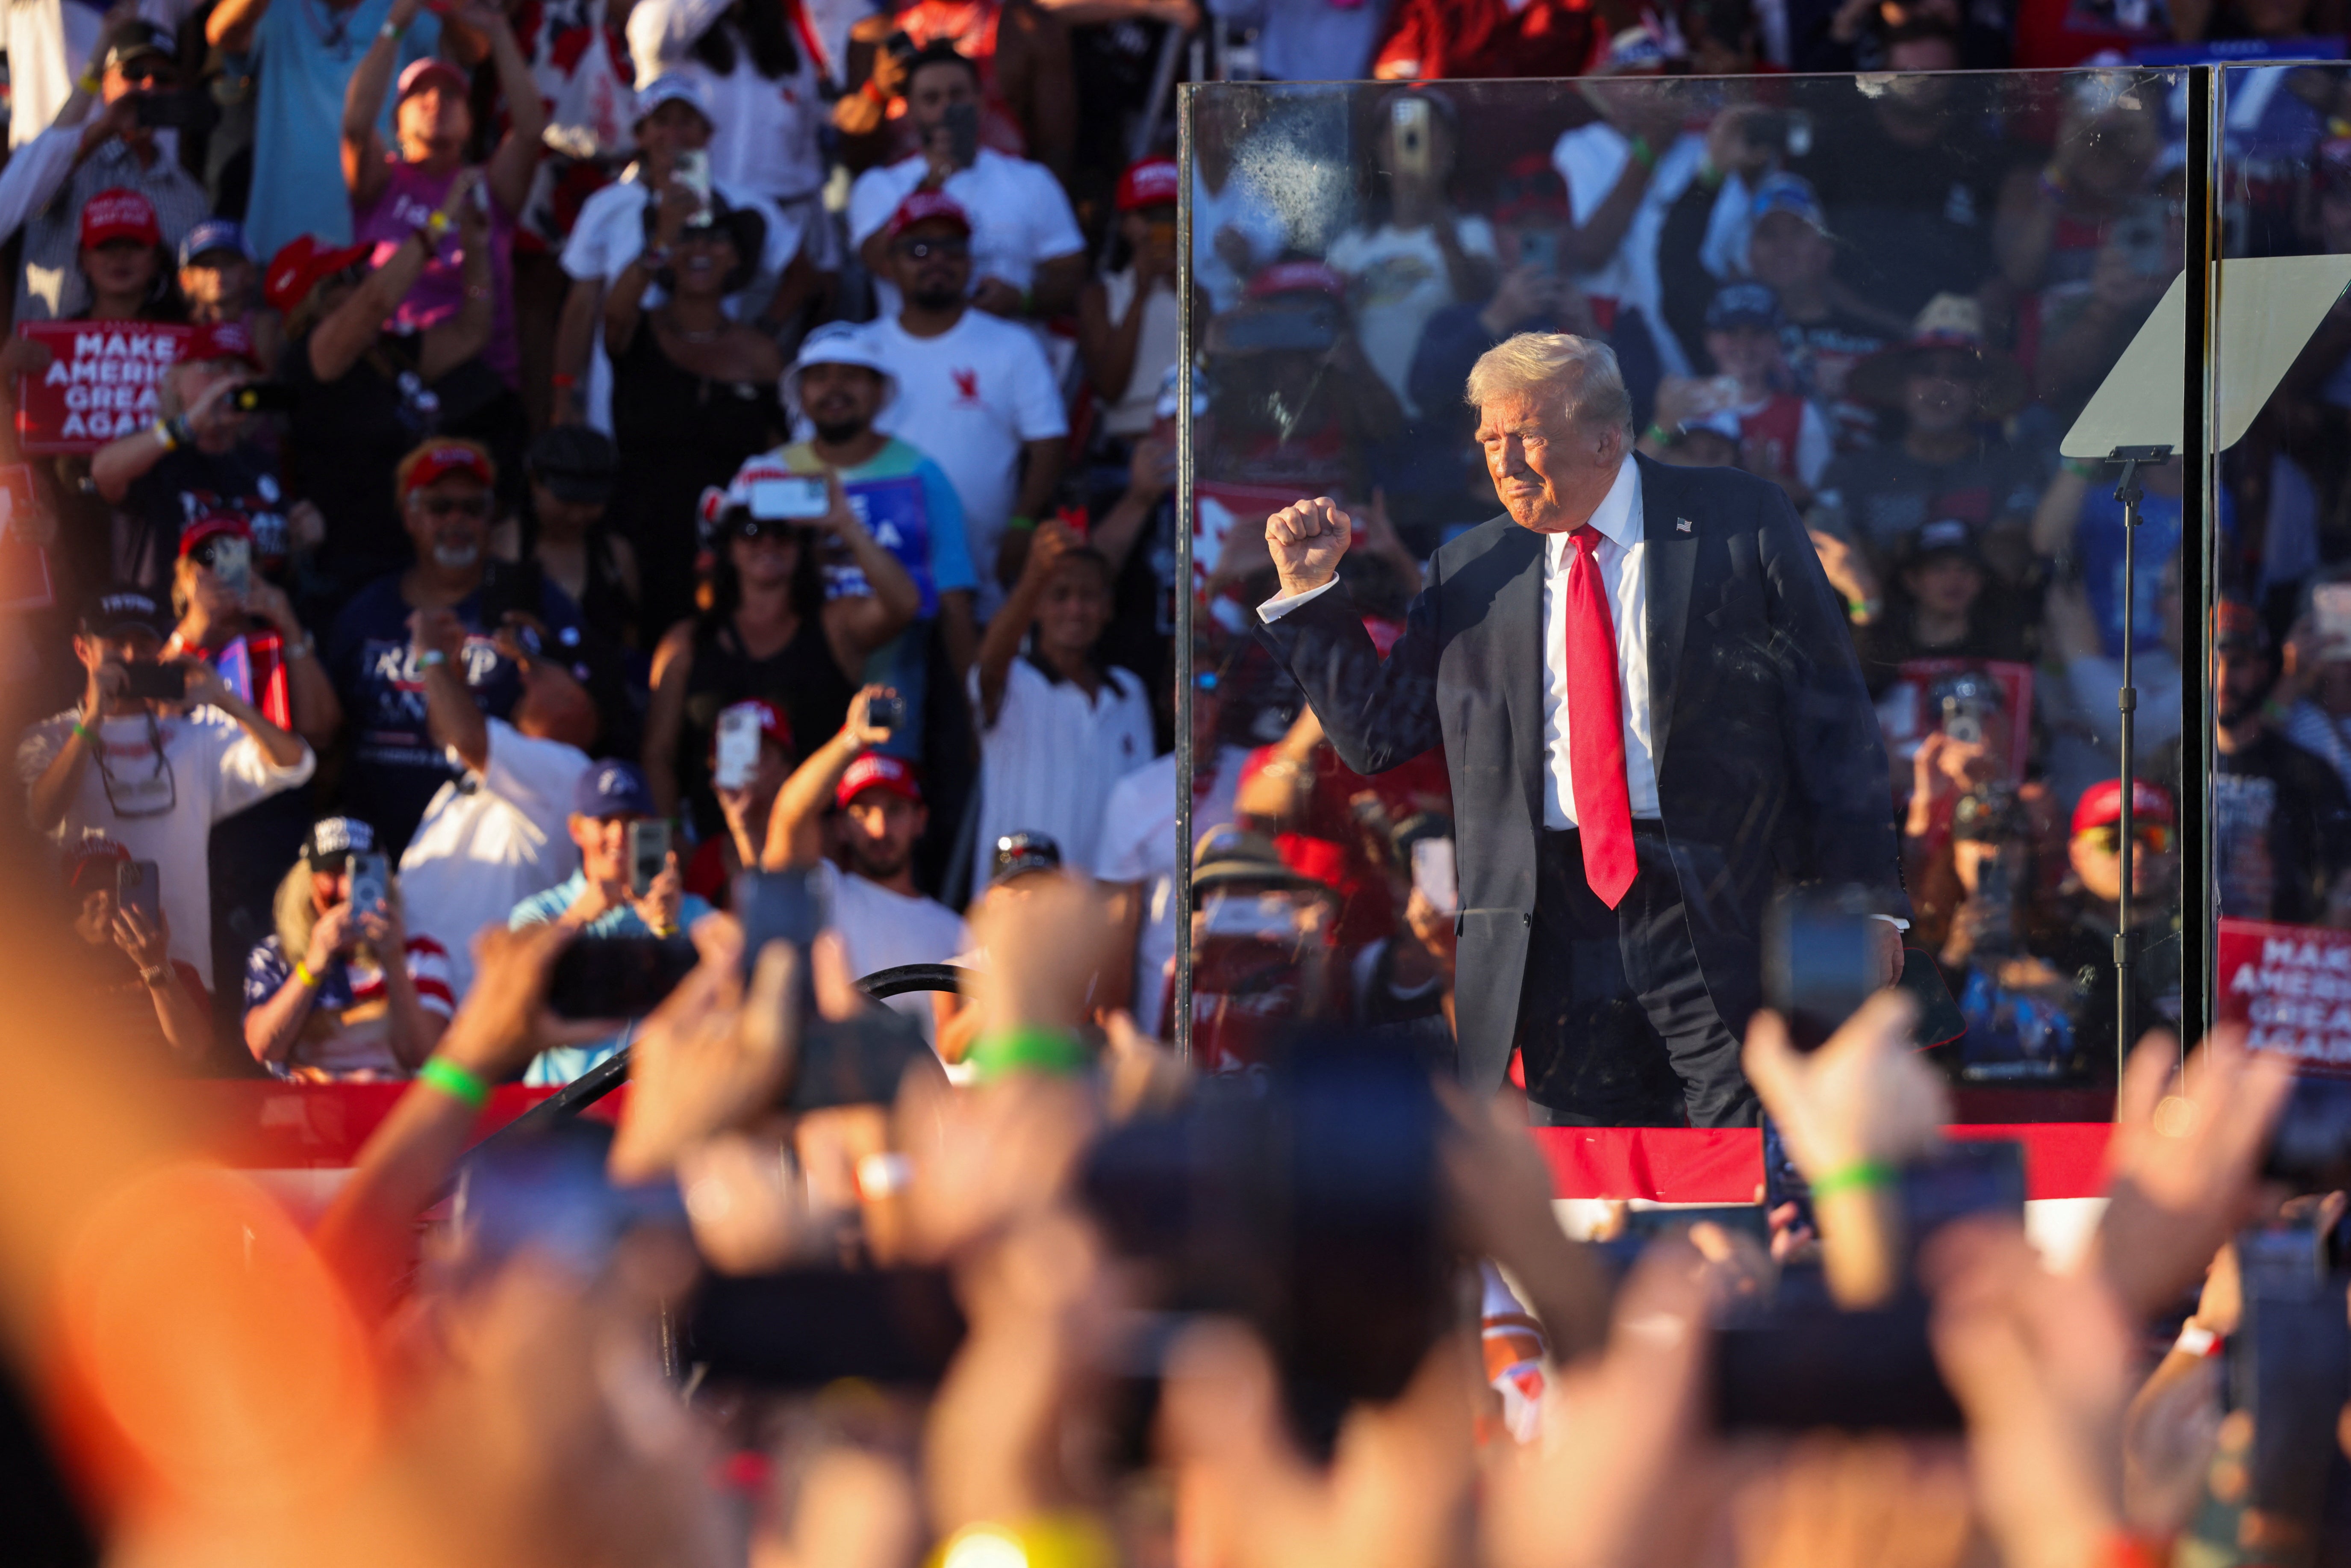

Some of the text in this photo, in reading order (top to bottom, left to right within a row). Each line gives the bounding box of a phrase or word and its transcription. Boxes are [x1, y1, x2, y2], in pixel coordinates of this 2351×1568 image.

[74, 332, 176, 361] MAKE
[64, 385, 161, 412] GREA
[2263, 938, 2351, 971] MAK
[2248, 994, 2351, 1033] GREA
